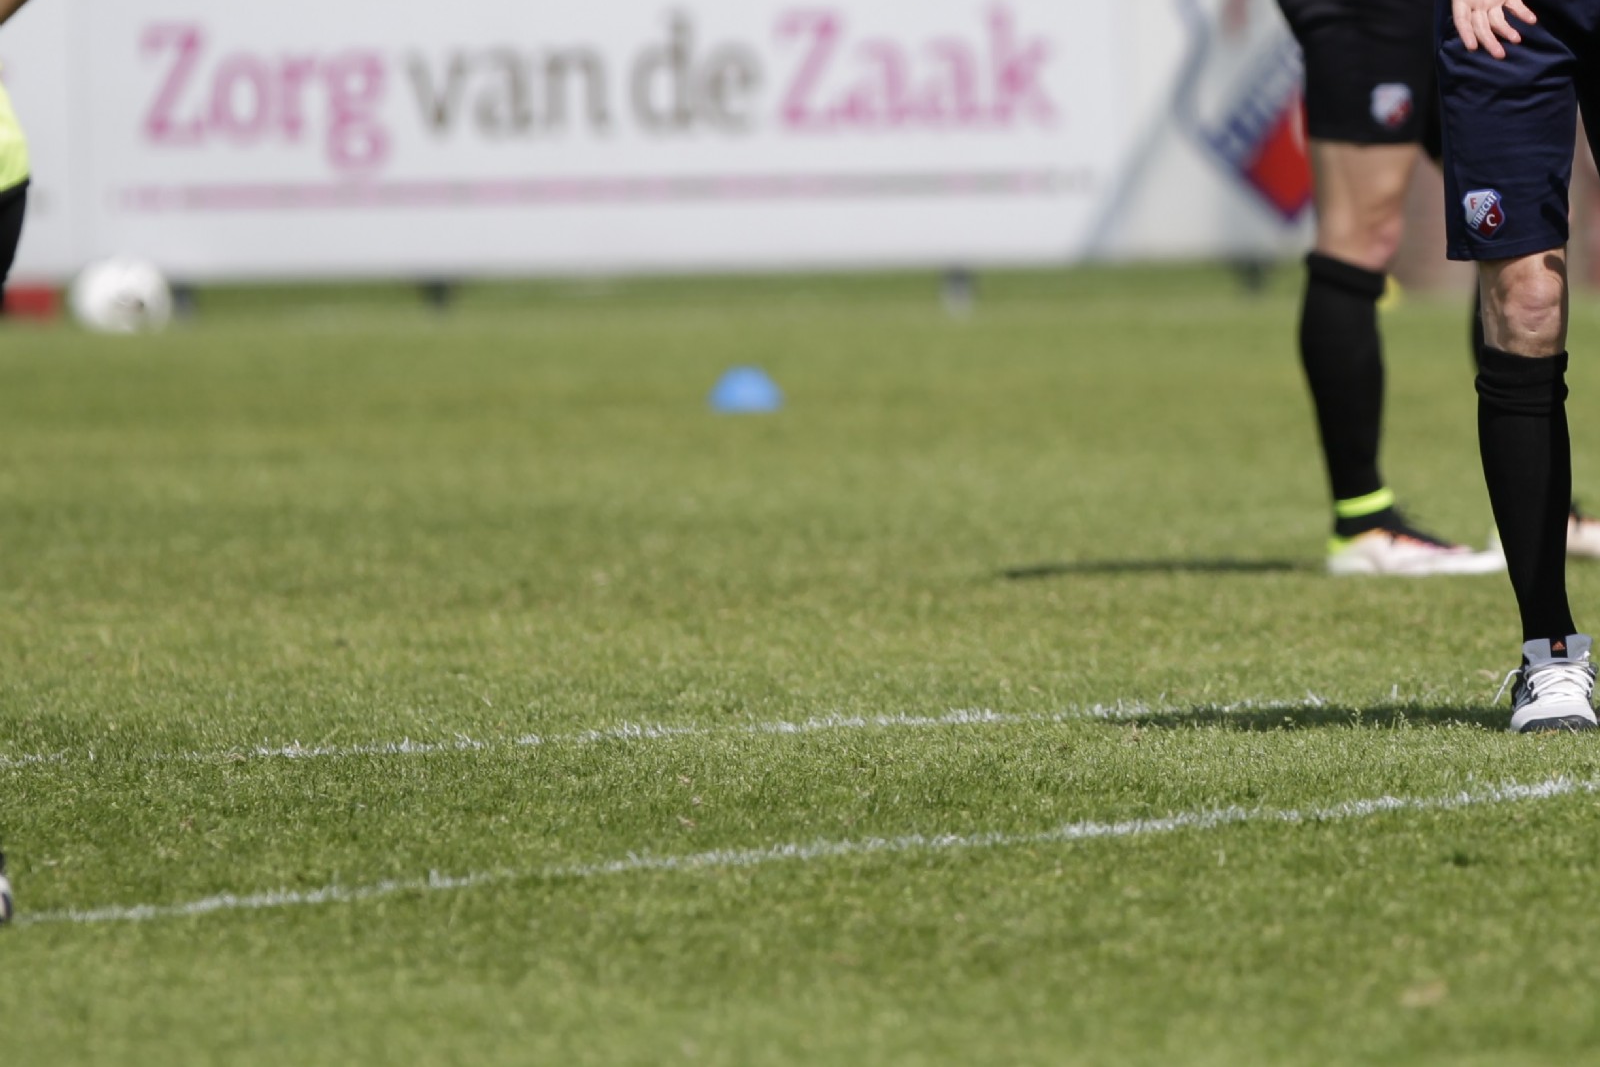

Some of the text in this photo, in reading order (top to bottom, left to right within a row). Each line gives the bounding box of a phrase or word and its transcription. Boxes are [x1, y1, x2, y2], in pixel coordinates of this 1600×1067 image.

[138, 22, 394, 172] Zorg
[406, 38, 610, 137] van
[630, 4, 762, 135] de
[1486, 213, 1498, 227] C
